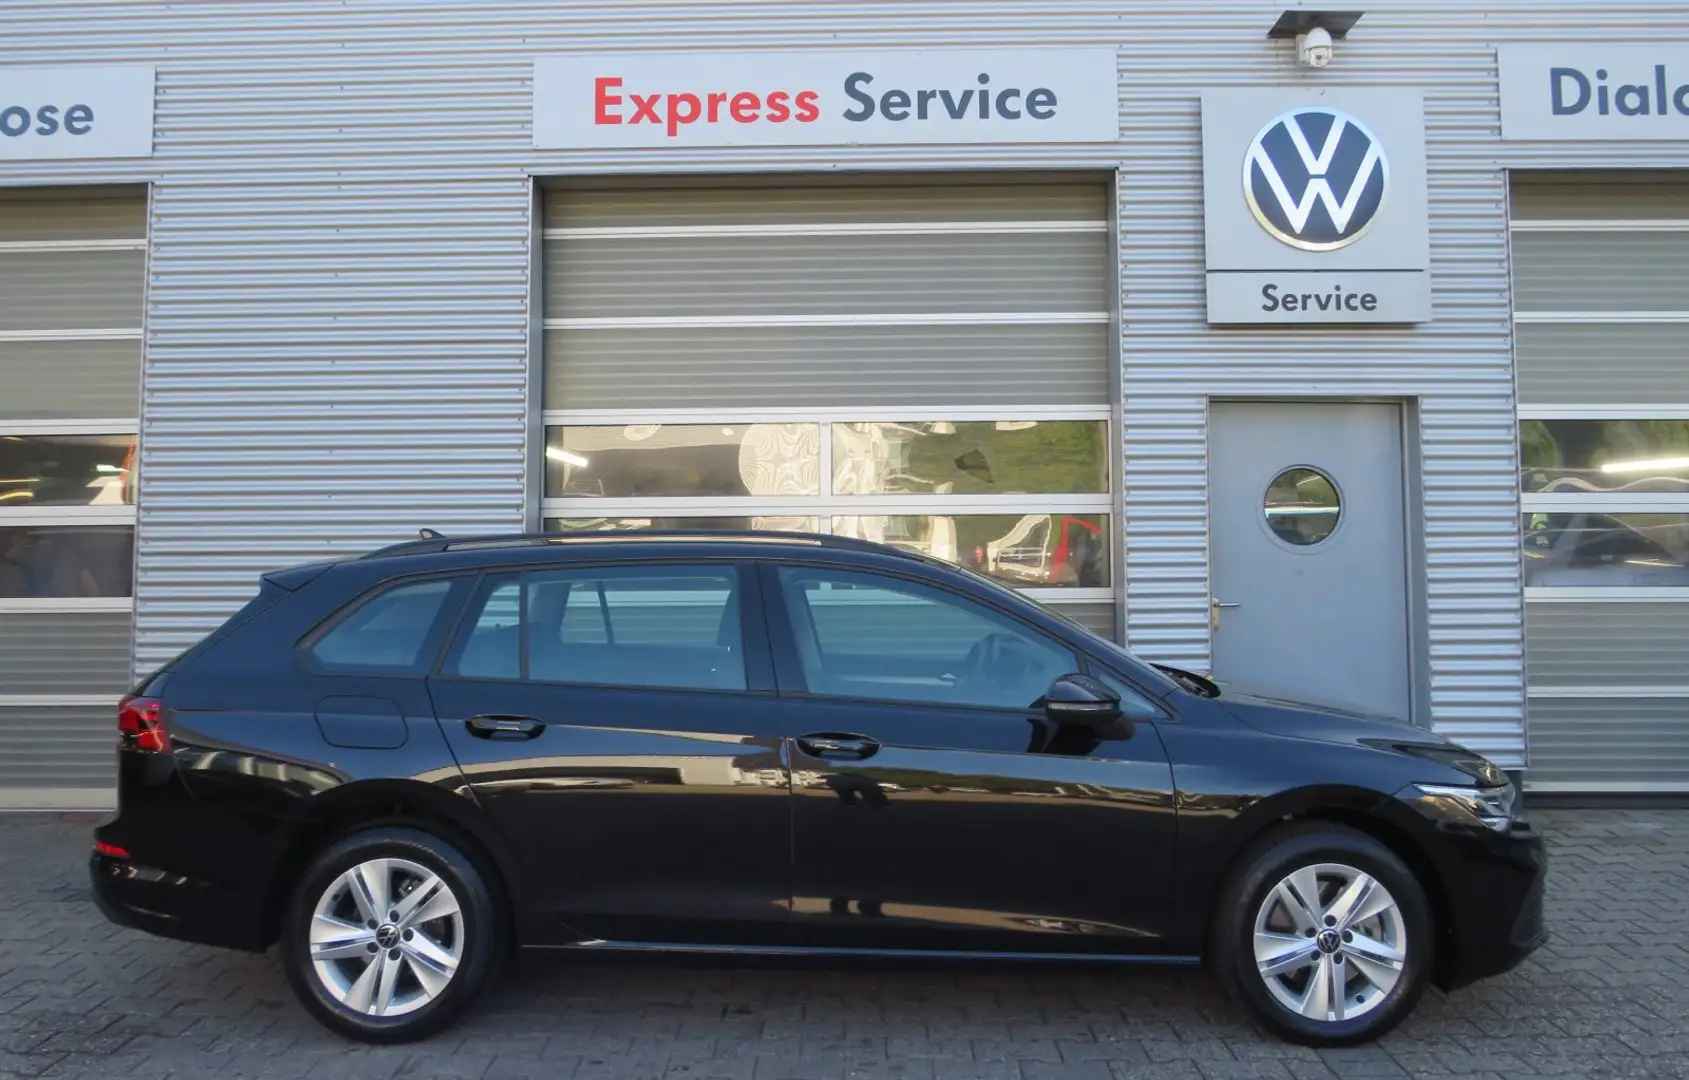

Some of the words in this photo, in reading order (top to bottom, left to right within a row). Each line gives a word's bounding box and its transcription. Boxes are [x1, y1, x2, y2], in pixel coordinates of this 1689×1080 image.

[0, 104, 94, 137] ose
[594, 77, 820, 137] Express
[842, 71, 1058, 122] Service
[1247, 110, 1386, 242] VW
[1261, 283, 1378, 312] Service
